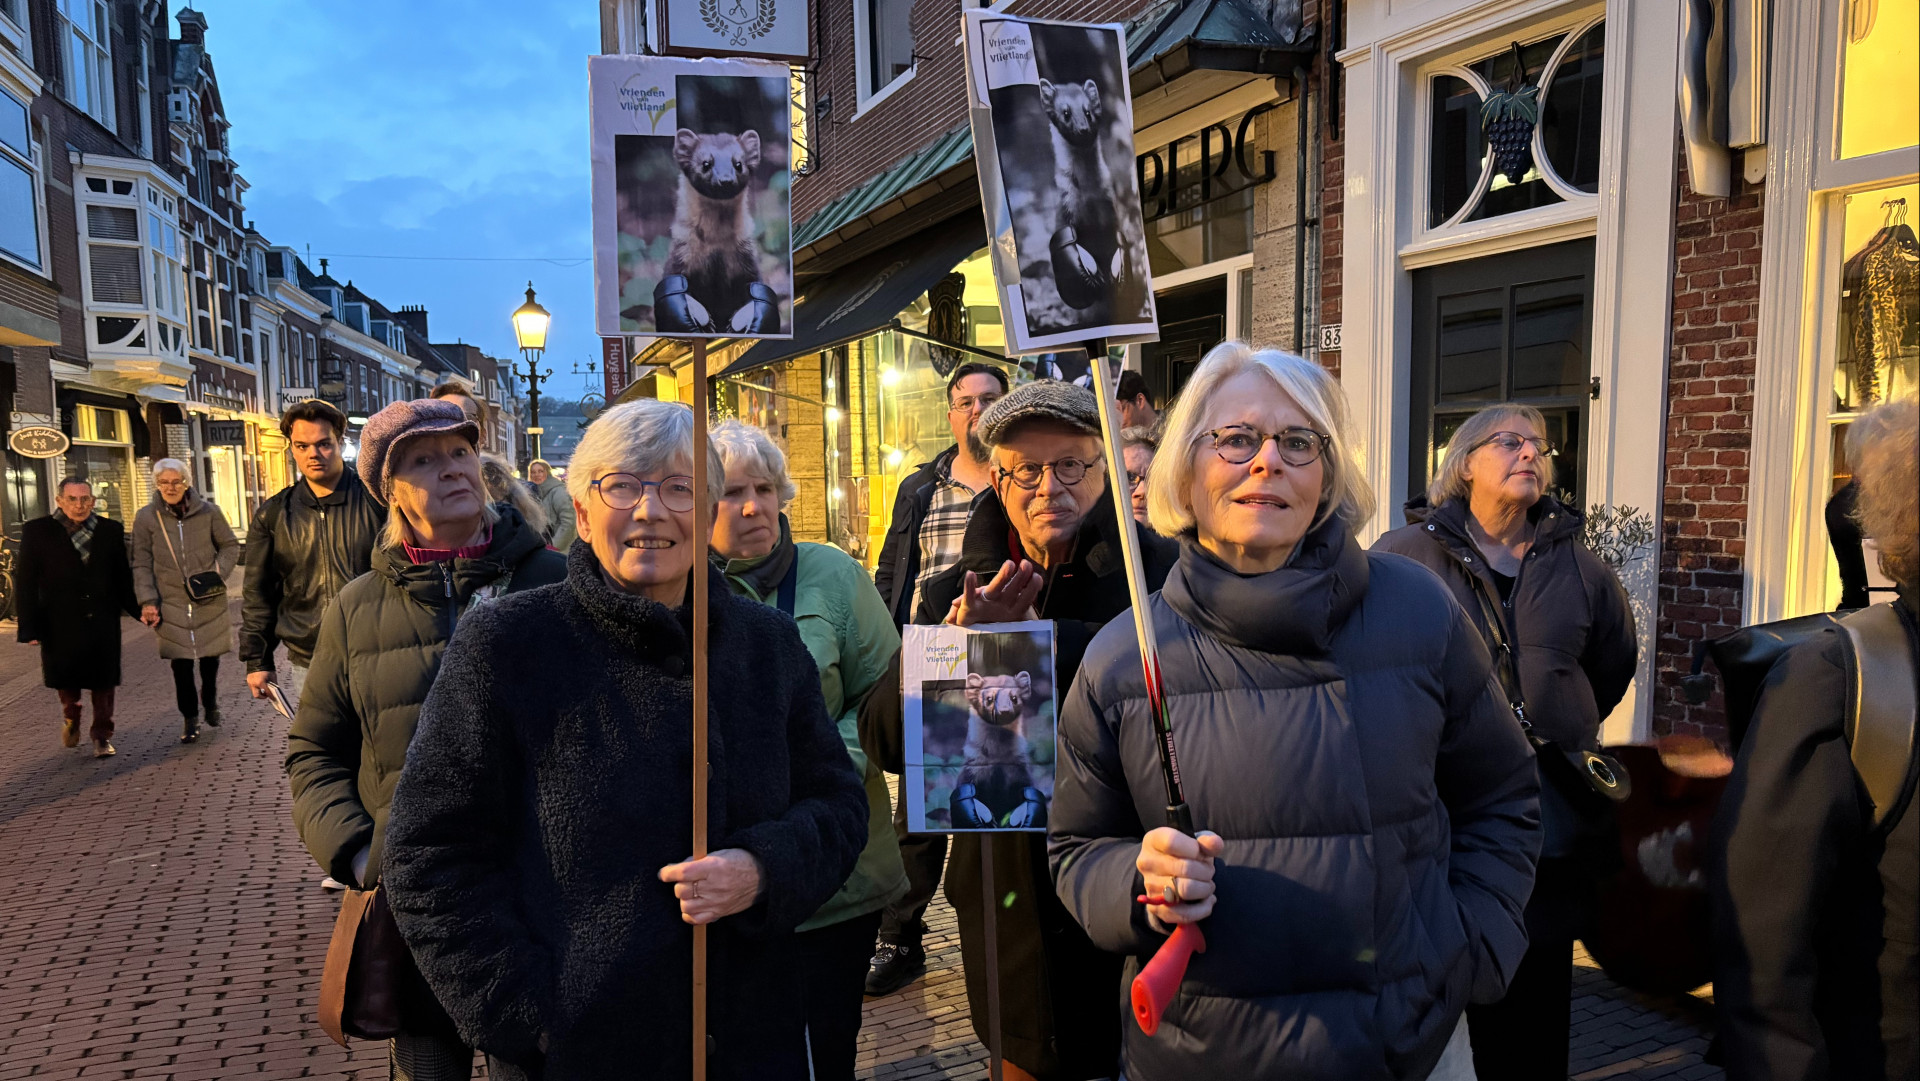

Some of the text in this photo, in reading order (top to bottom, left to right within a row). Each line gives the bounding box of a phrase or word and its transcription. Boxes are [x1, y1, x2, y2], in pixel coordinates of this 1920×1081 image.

[989, 37, 1026, 48] Vrienden
[990, 51, 1029, 63] Vlietland
[620, 87, 665, 98] Vrienden
[620, 102, 666, 112] Vlietland
[1324, 328, 1341, 347] 83
[609, 343, 621, 396] Huygens
[210, 426, 243, 441] RITZZ
[926, 645, 960, 653] Vrienden
[926, 655, 960, 663] Vlietland
